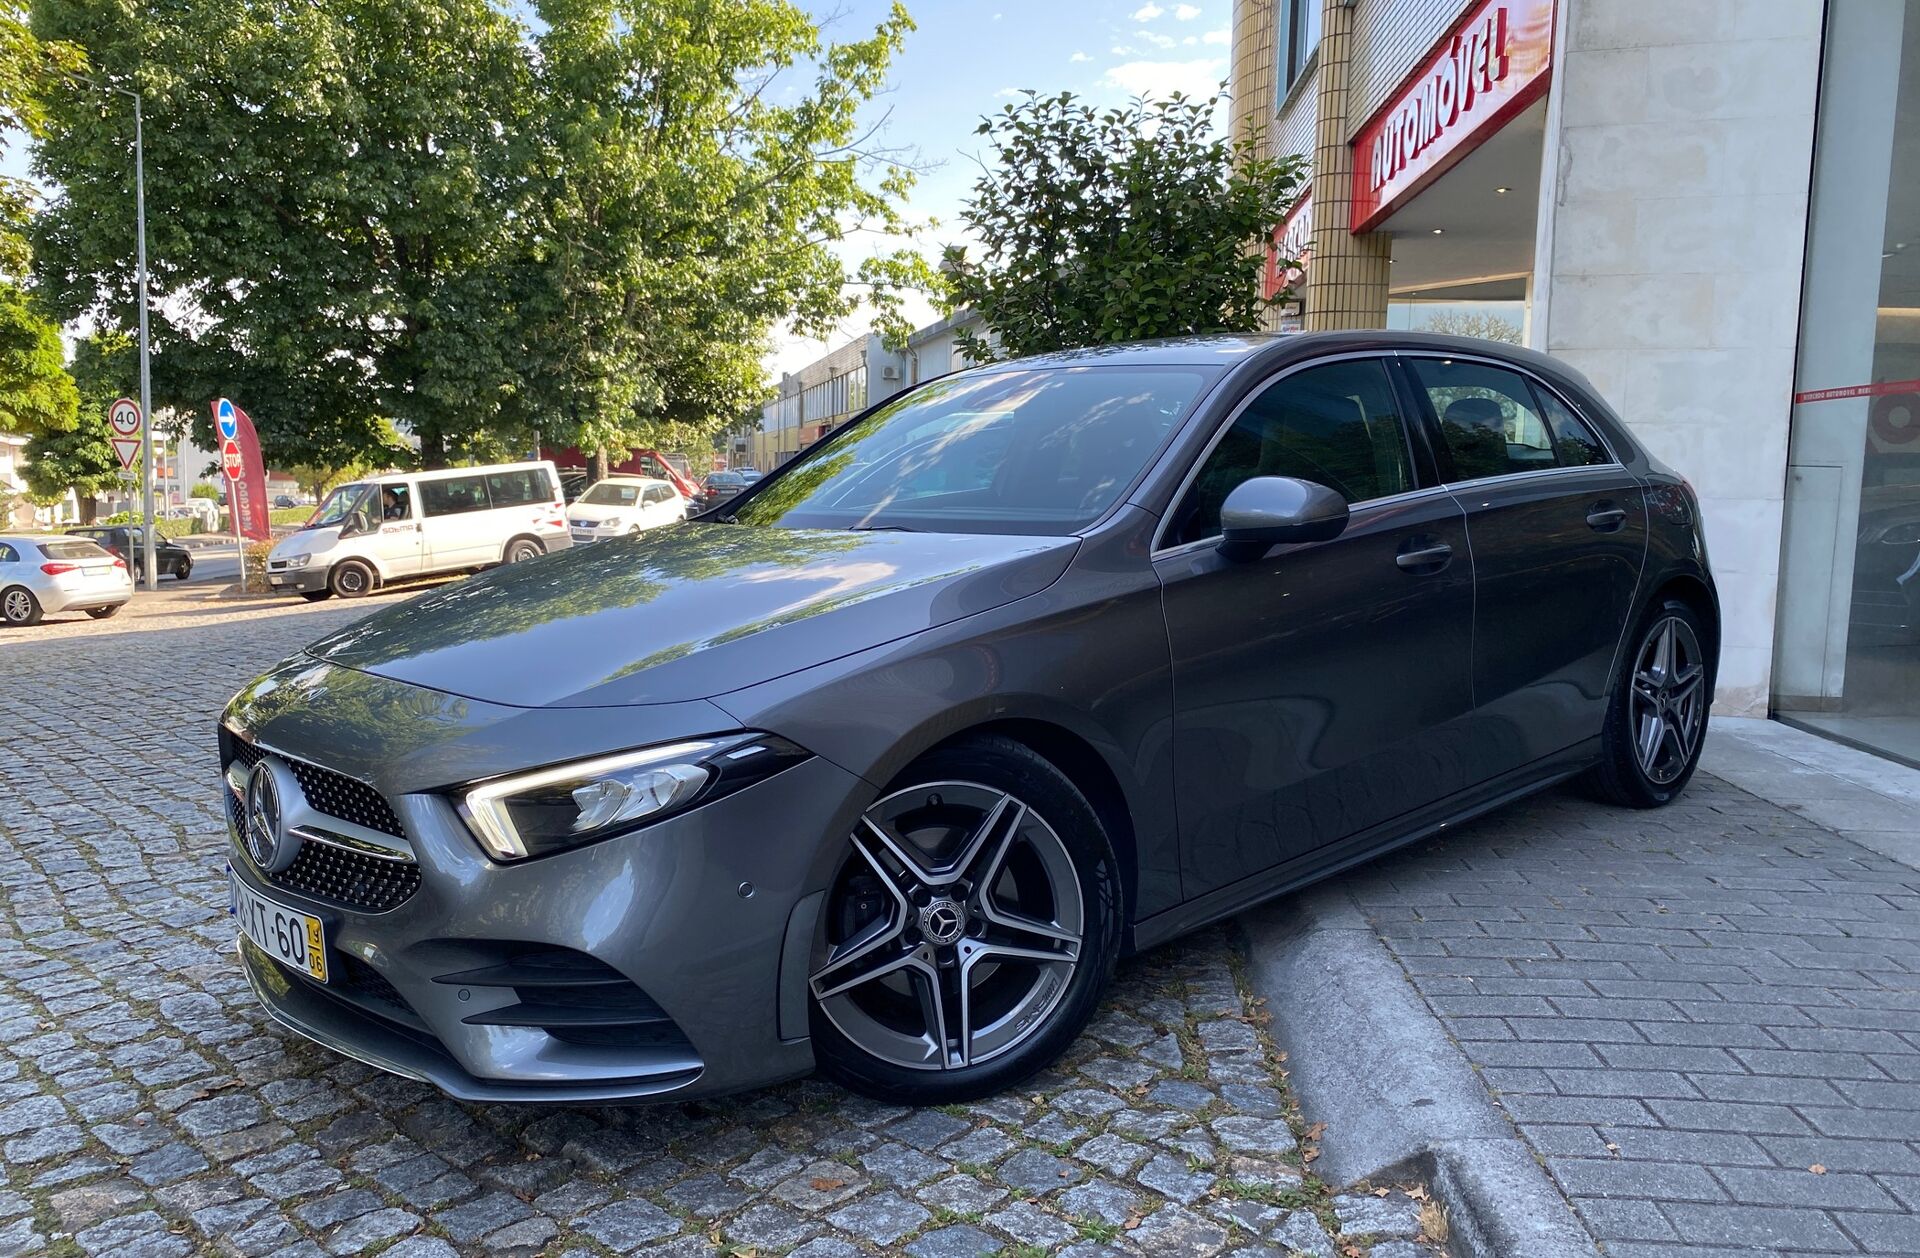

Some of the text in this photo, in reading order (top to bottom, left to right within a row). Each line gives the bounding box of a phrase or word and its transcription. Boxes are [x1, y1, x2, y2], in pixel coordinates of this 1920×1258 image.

[1371, 8, 1508, 192] AUTOMÓVEL
[115, 411, 136, 425] 40
[225, 454, 241, 468] STOP
[306, 923, 320, 943] 19
[309, 953, 323, 972] 06
